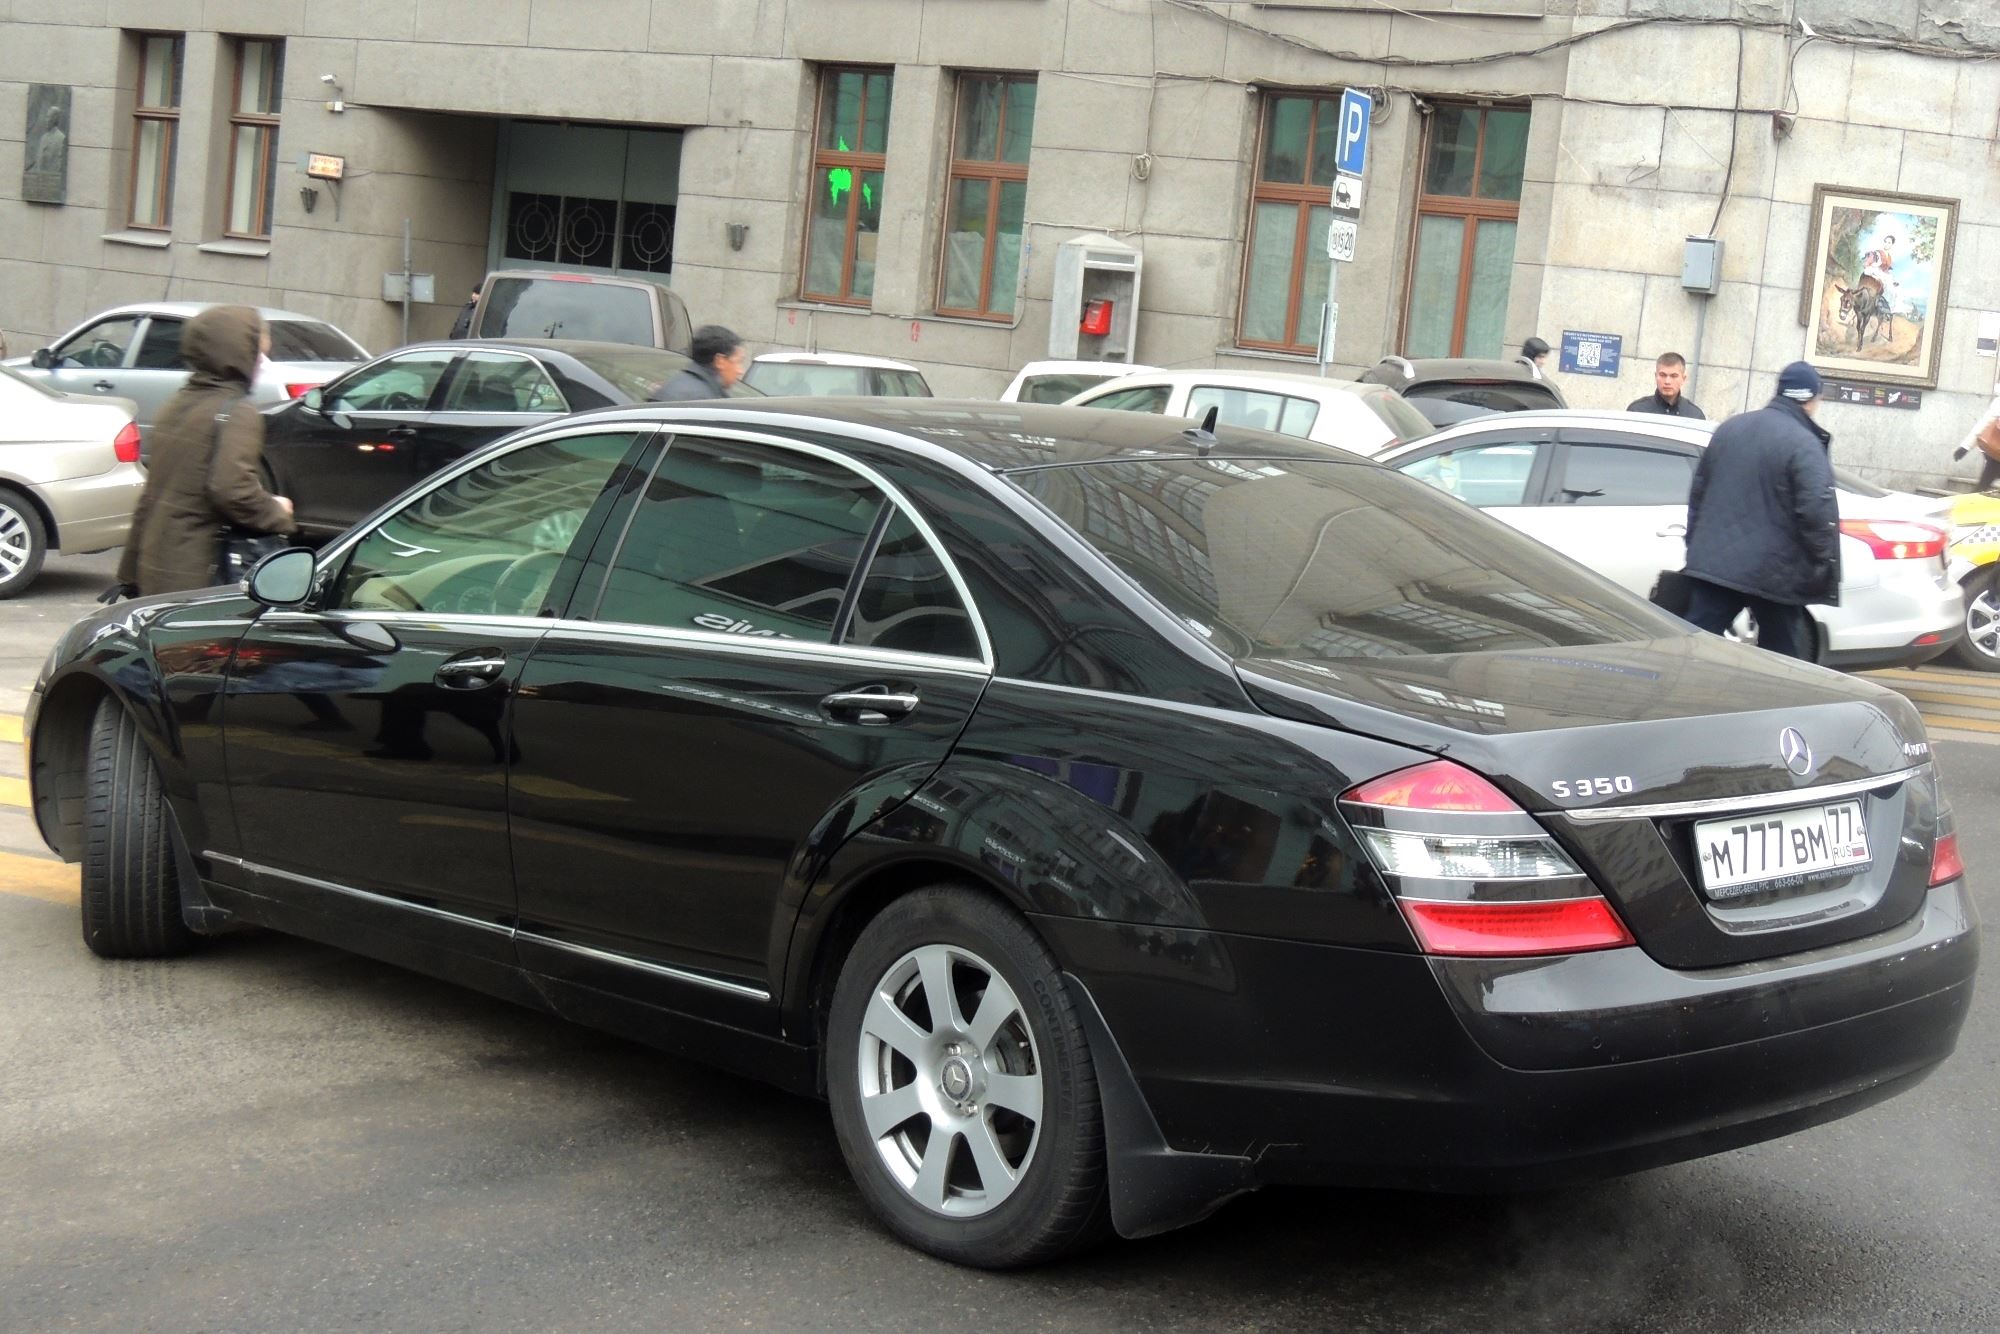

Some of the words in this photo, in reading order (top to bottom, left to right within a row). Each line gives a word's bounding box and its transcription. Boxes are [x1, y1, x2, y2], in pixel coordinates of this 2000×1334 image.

[1344, 102, 1363, 162] P
[1344, 231, 1353, 251] 20
[1552, 780, 1571, 798] S
[1575, 776, 1633, 797] 350
[1828, 806, 1852, 844] 77
[1834, 847, 1852, 859] RUS
